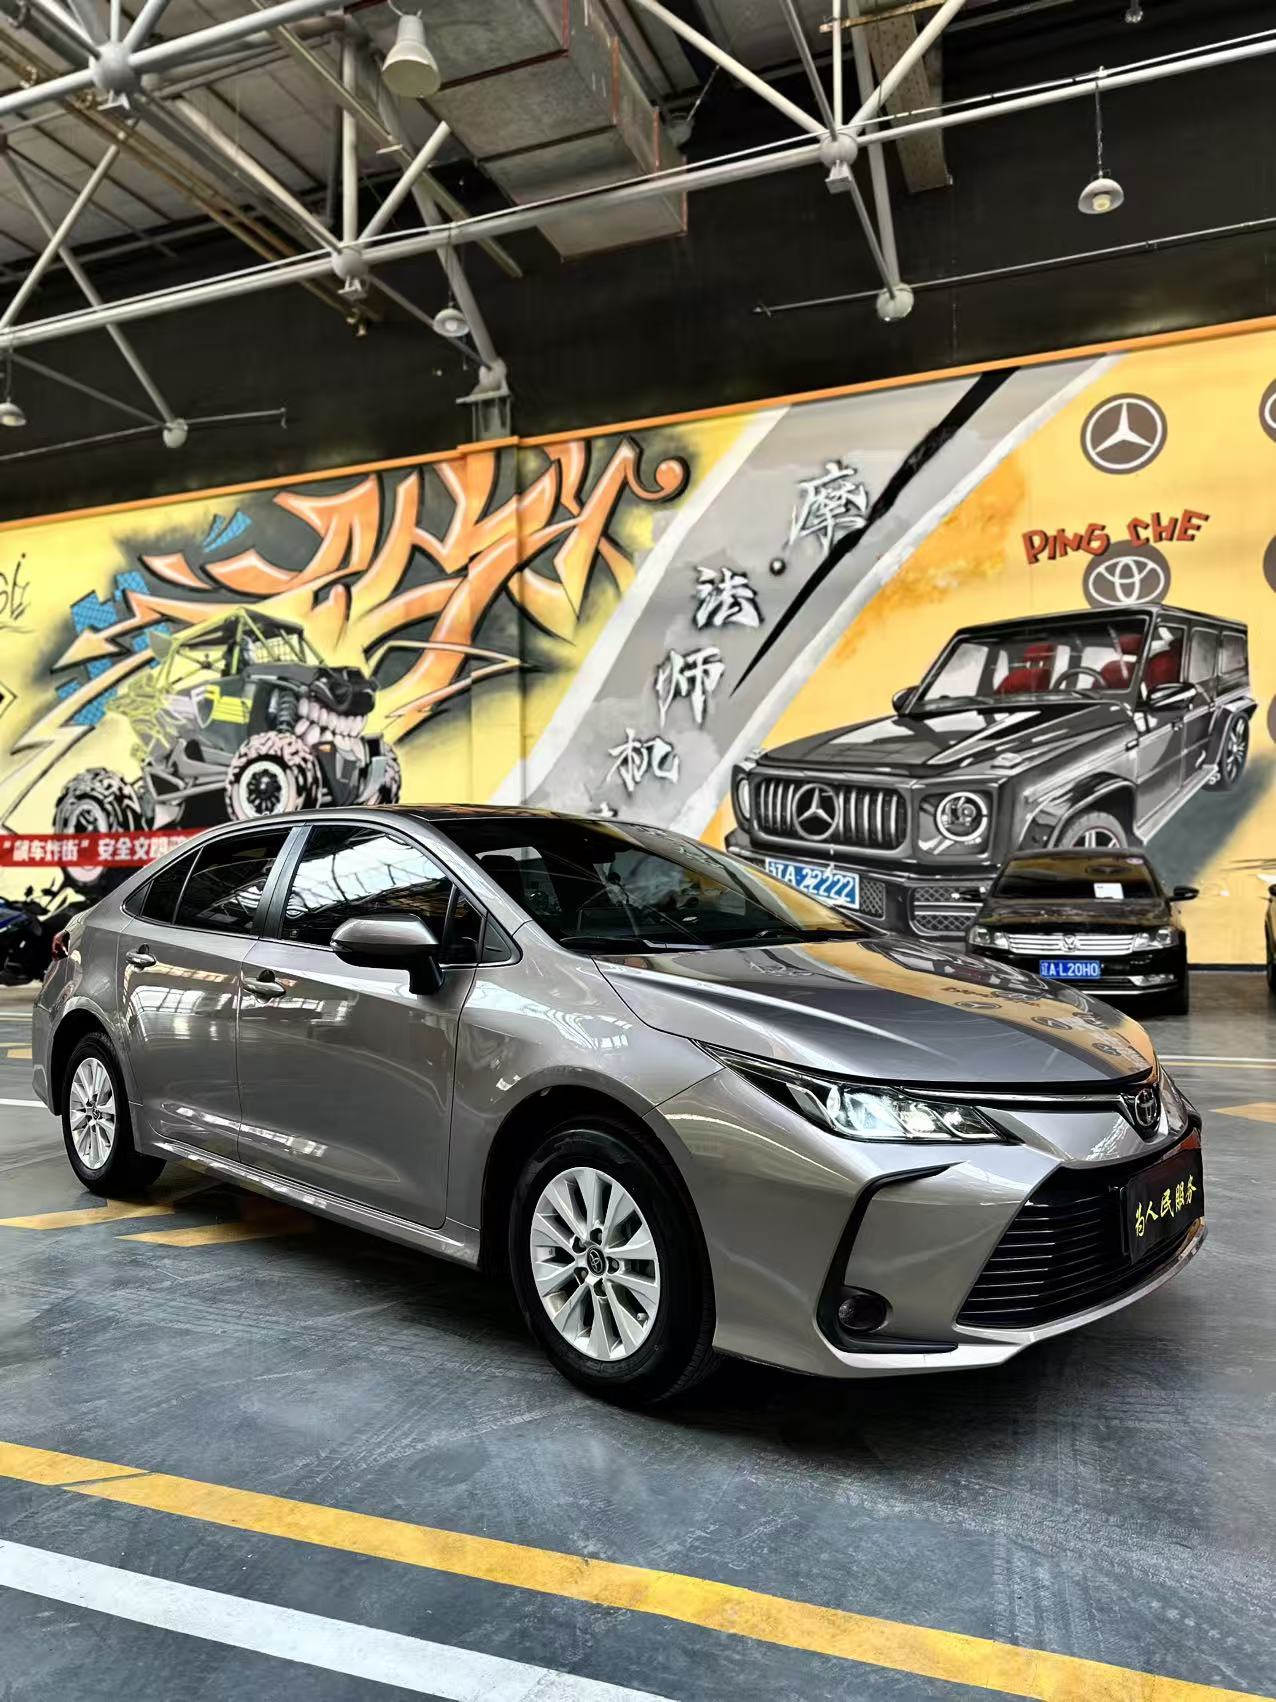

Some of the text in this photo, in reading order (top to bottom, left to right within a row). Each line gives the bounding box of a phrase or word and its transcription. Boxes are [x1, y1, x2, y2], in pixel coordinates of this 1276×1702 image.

[1022, 509, 1211, 565] PING CHE
[1135, 1174, 1197, 1237] 为人民服务
